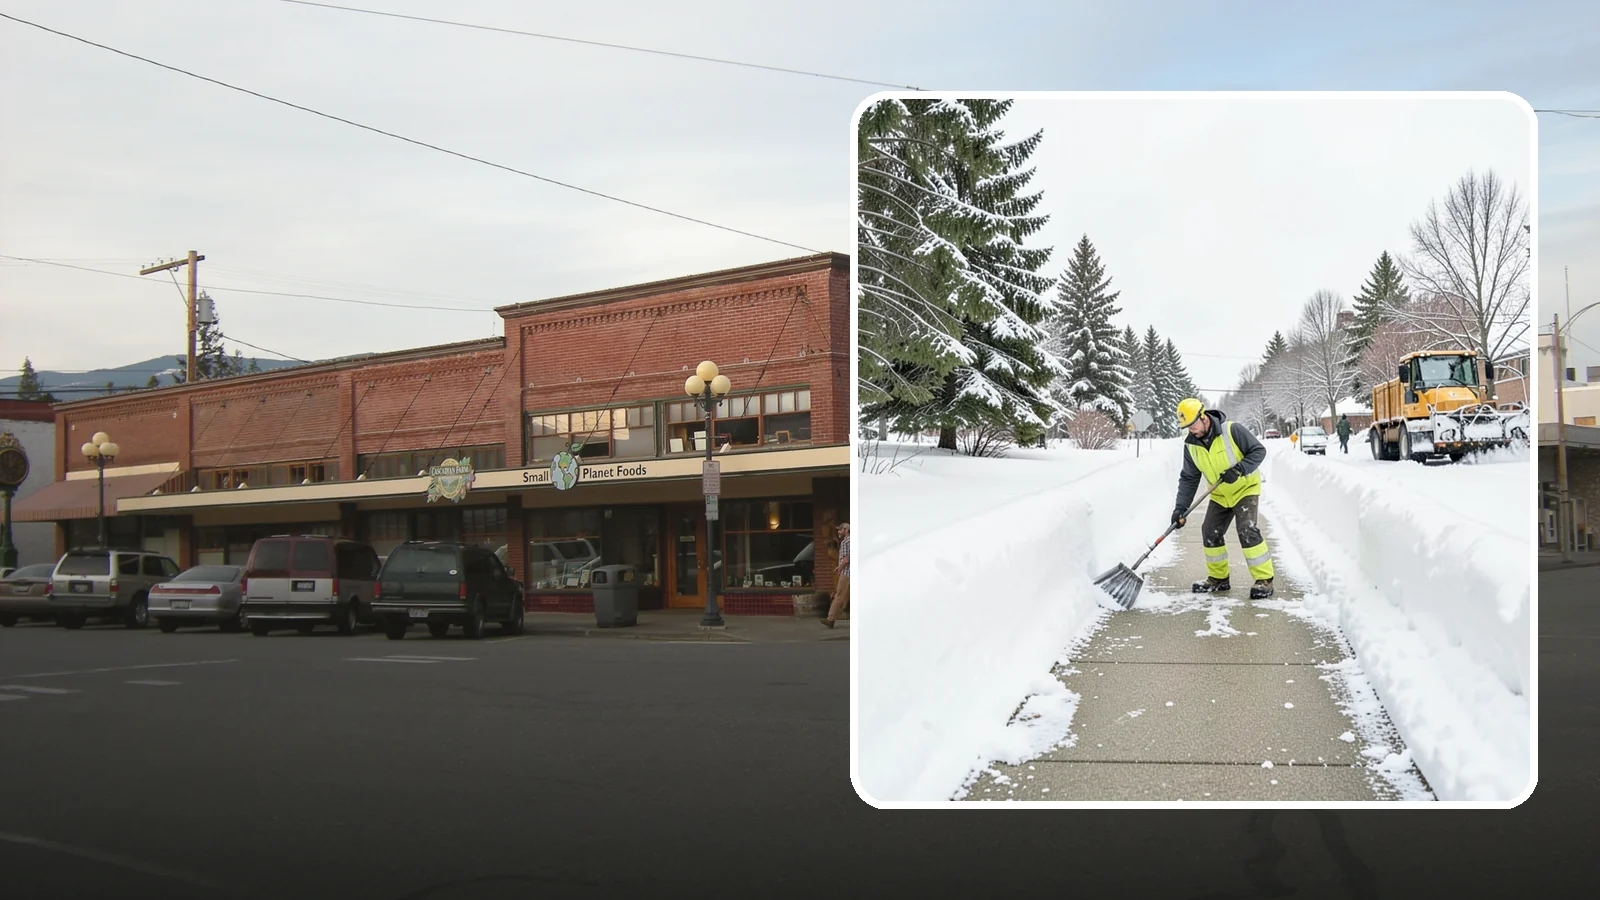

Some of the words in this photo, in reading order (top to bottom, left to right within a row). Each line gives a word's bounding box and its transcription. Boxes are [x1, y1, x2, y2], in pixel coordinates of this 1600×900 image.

[523, 471, 549, 483] Small
[583, 467, 614, 479] Planet
[617, 464, 647, 476] Foods
